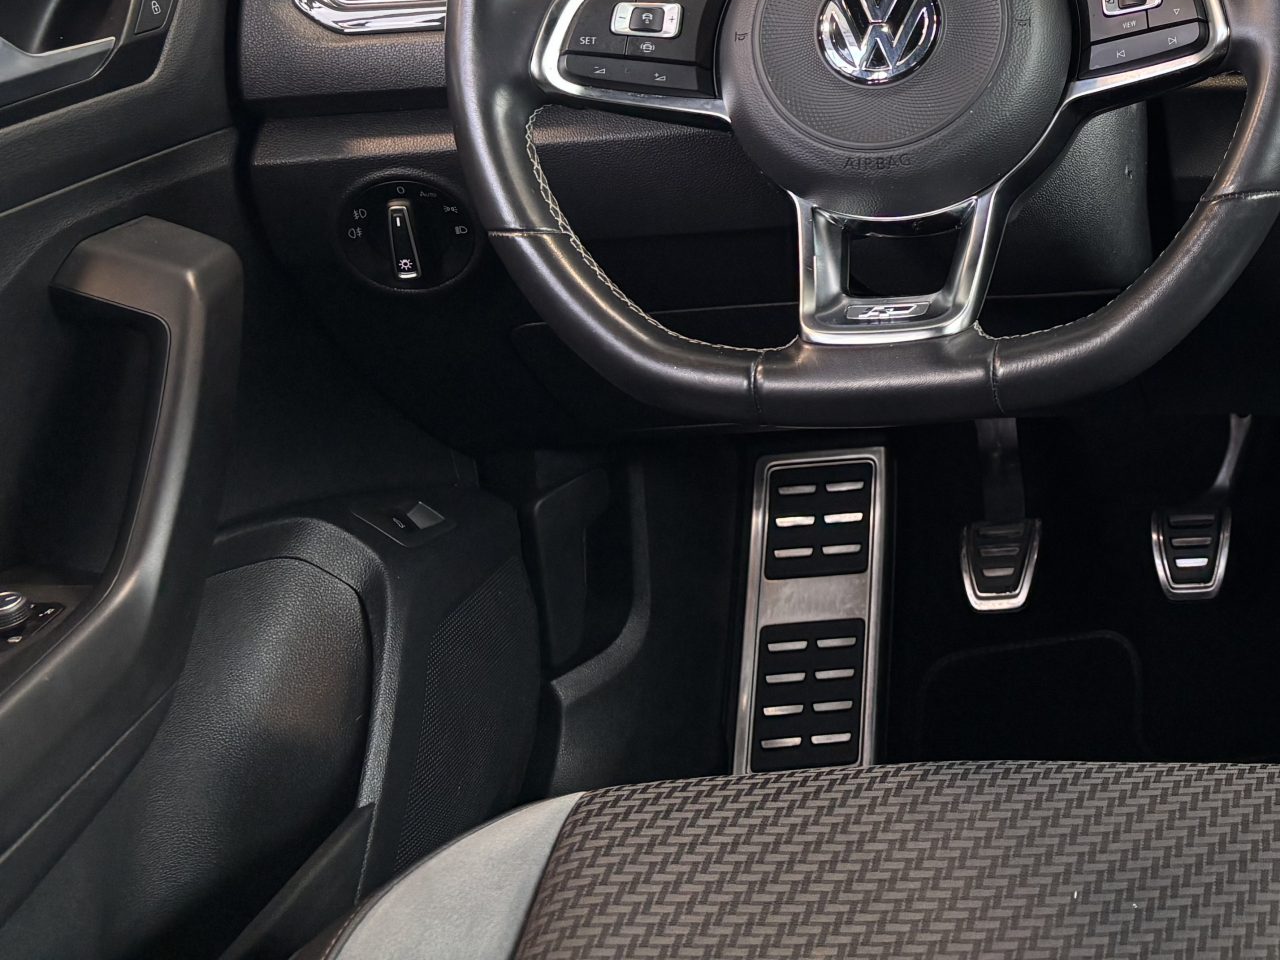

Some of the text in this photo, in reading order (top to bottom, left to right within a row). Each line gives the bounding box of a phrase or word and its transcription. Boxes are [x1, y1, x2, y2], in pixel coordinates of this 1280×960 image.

[1122, 20, 1137, 29] VIEW
[579, 36, 597, 45] SET
[843, 154, 912, 171] AIRBAG
